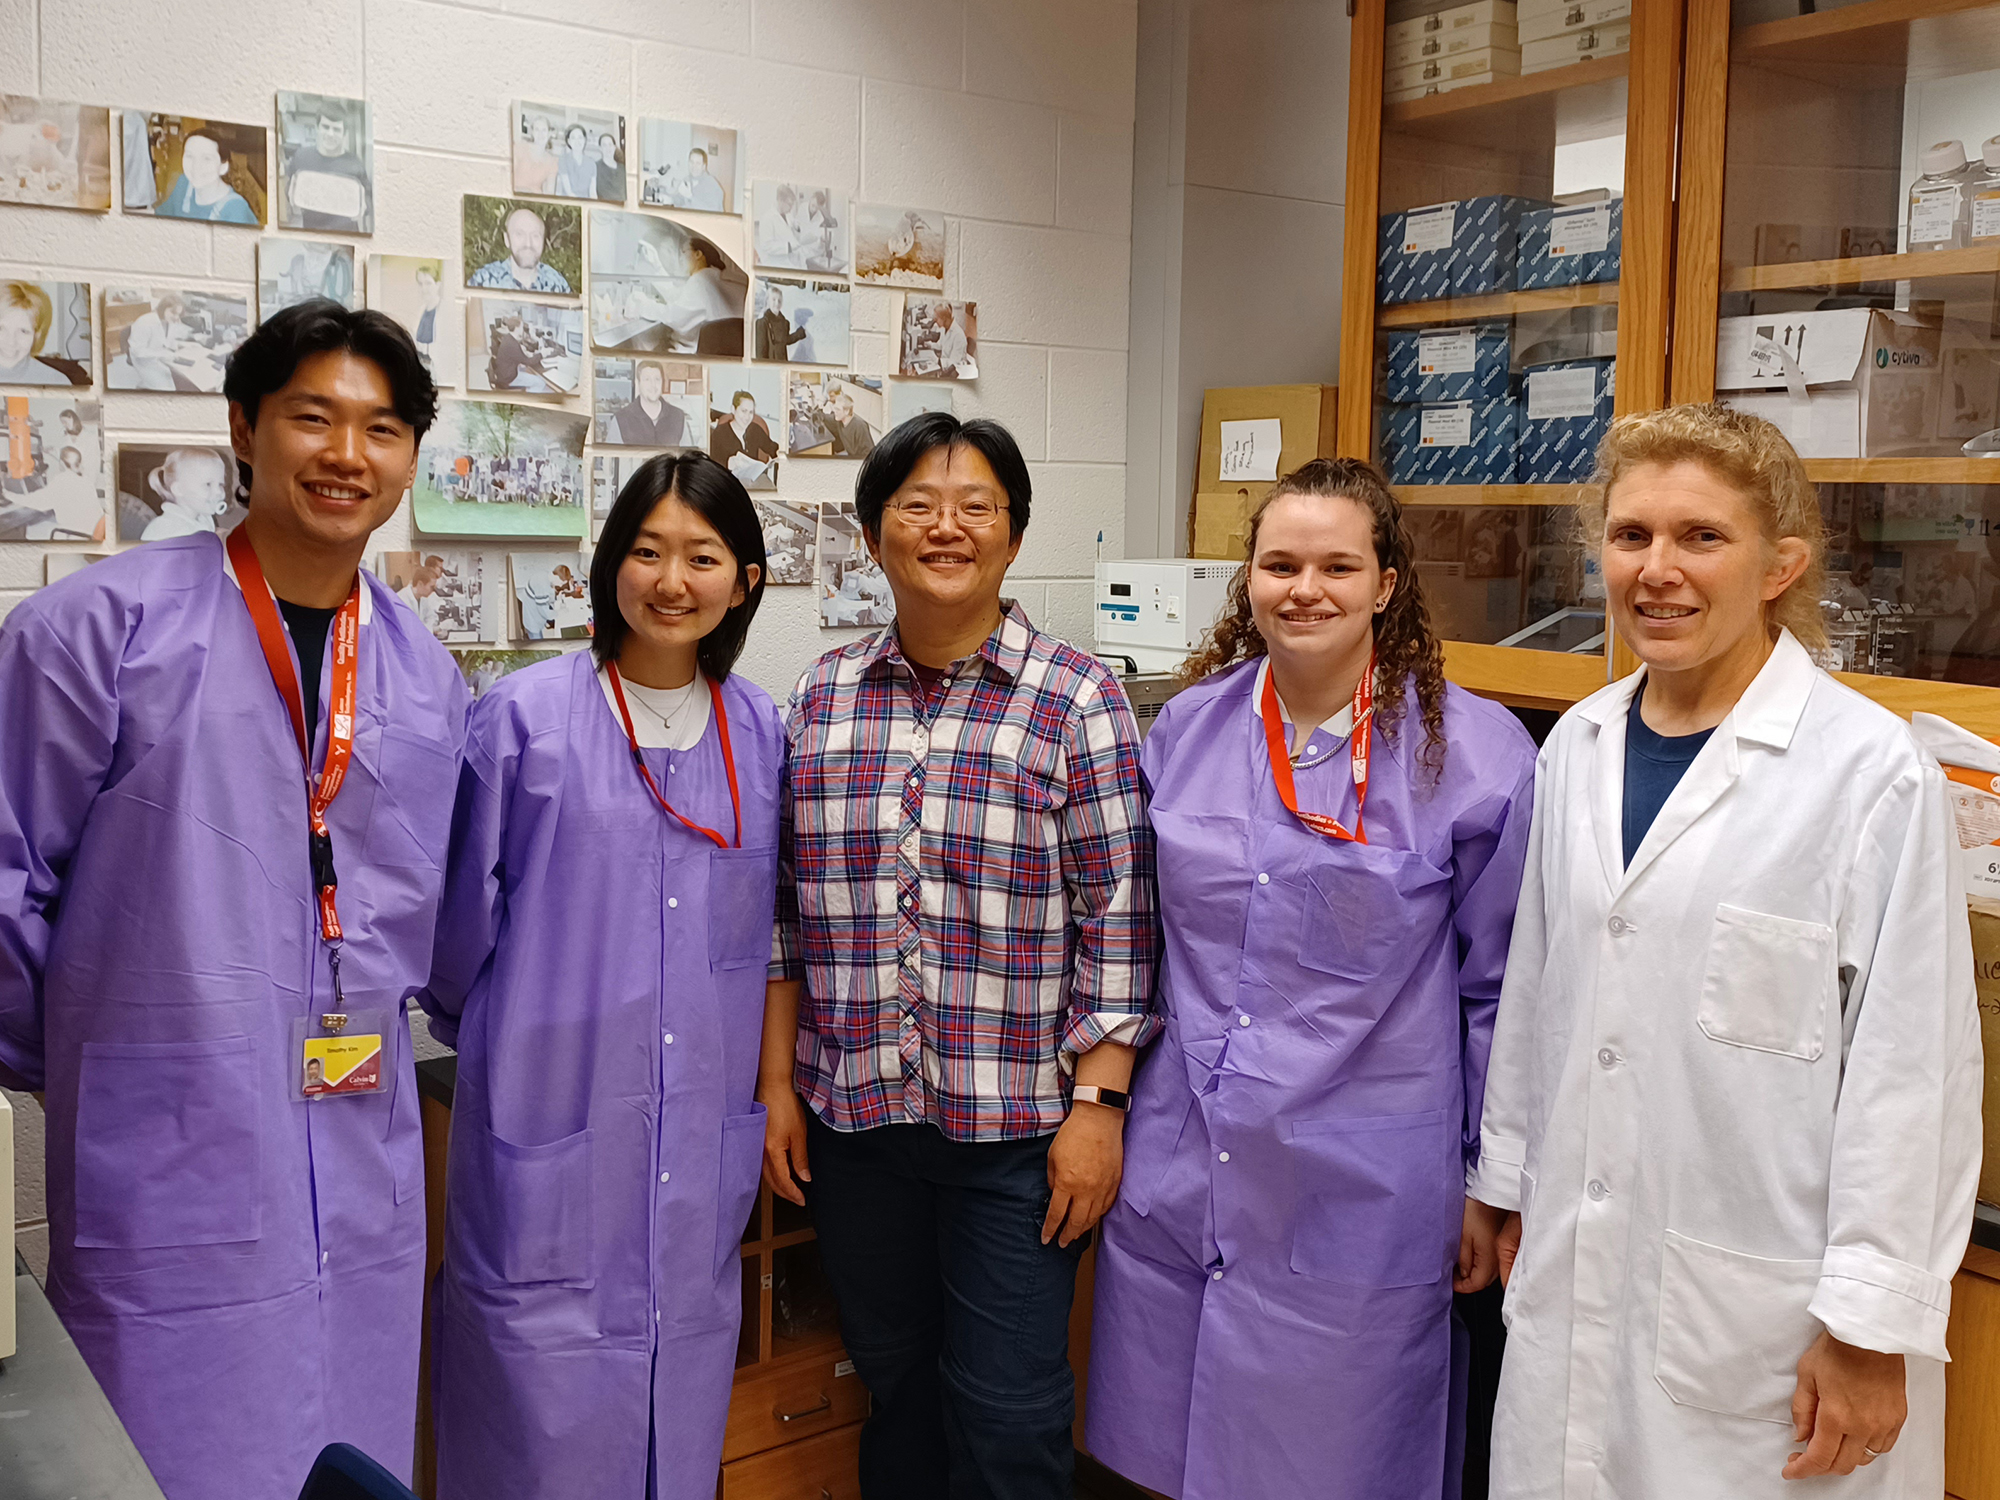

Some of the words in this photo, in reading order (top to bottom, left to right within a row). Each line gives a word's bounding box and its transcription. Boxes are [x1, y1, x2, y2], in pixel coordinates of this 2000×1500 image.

[1478, 201, 1498, 226] QIAGEN
[1386, 214, 1404, 238] QIAGEN
[1454, 216, 1473, 240] QIAGEN
[1517, 224, 1538, 249] QIAGEN
[1466, 232, 1486, 257] QIAGEN
[1443, 247, 1462, 272] QIAGEN
[1479, 249, 1499, 273] QIAGEN
[1543, 257, 1565, 282] QIAGEN
[1387, 260, 1405, 283] QIAGEN
[1421, 261, 1438, 285] QIAGEN
[1456, 263, 1474, 287] QIAGEN
[1399, 276, 1416, 300] QIAGEN
[1891, 349, 1921, 367] cytiva
[1481, 364, 1501, 388] QIAGEN
[1455, 377, 1475, 399] QIAGEN
[1480, 396, 1500, 419] QIAGEN
[1400, 416, 1418, 437] QIAGEN
[1494, 413, 1514, 436] QIAGEN
[1579, 417, 1599, 440] QIAGEN
[1470, 426, 1488, 448] QIAGEN
[1553, 429, 1573, 453] QIAGEN
[1392, 443, 1408, 465] QIAGEN
[1425, 449, 1443, 471] QIAGEN
[1484, 443, 1503, 465] QIAGEN
[1530, 441, 1549, 464] QIAGEN
[1568, 447, 1588, 470] QIAGEN
[1404, 460, 1421, 481] QIAGEN
[1461, 454, 1479, 477] QIAGEN
[1543, 460, 1563, 482] QIAGEN
[349, 1076, 369, 1084] Calvin
